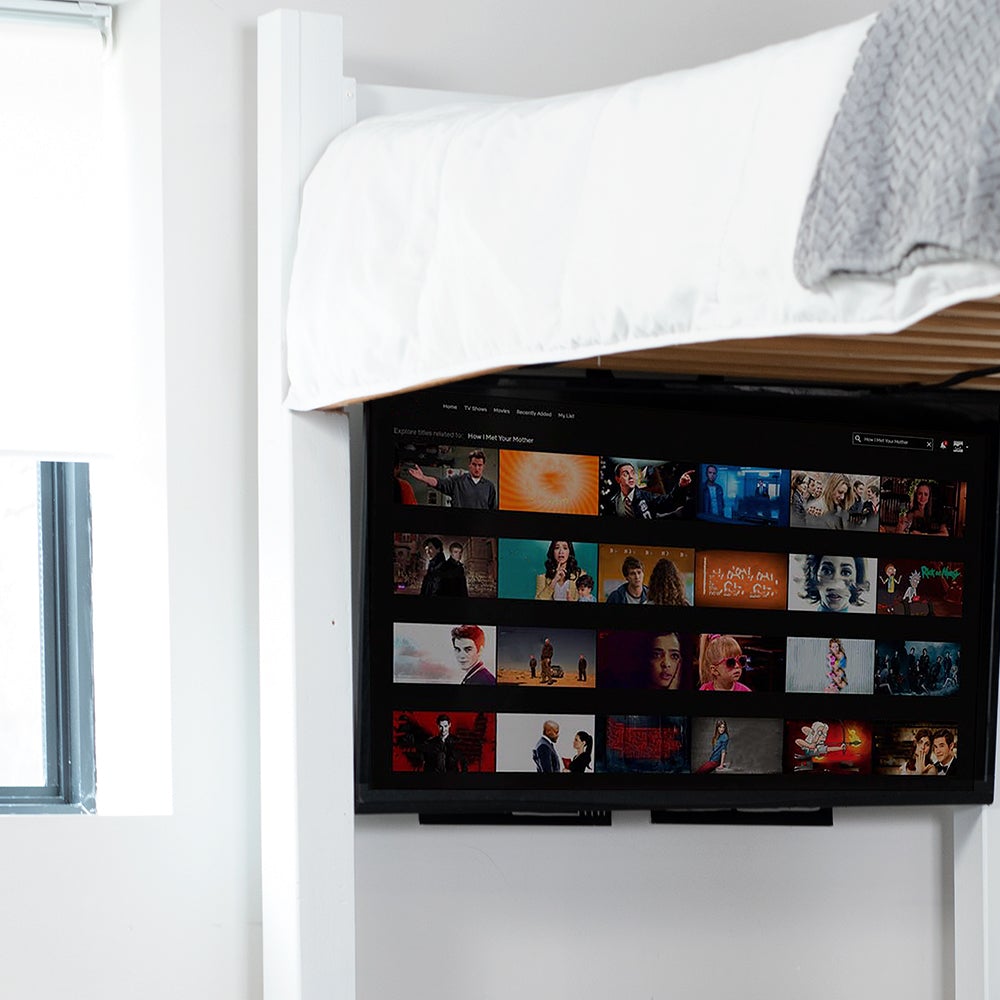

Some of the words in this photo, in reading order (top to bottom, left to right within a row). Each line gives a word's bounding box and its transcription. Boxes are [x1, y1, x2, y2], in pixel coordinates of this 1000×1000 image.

[516, 408, 536, 417] Recently
[393, 427, 416, 436] Explore
[417, 428, 432, 437] titles
[434, 430, 454, 439] related
